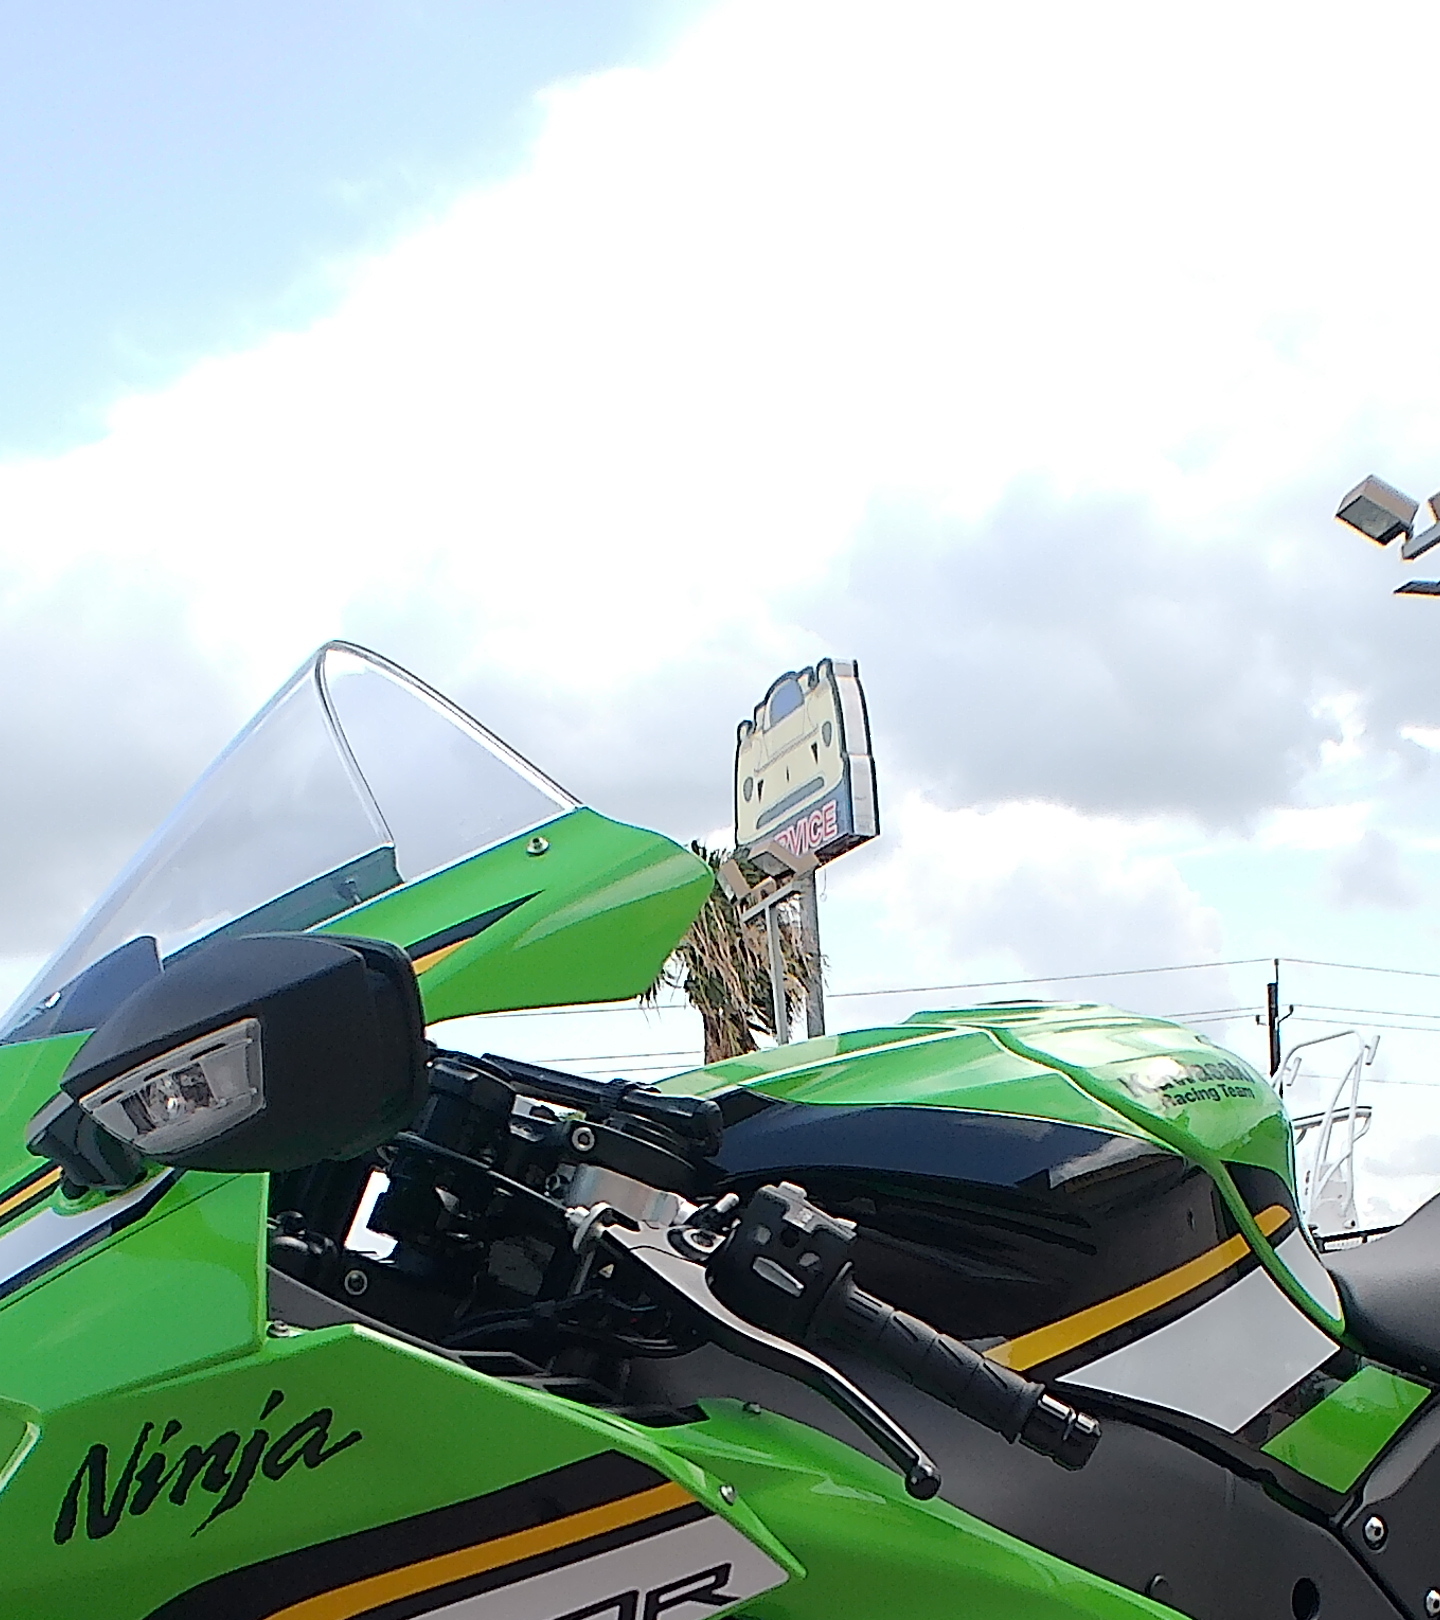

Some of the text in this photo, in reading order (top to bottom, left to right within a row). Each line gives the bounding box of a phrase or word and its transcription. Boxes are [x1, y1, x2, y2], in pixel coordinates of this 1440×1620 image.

[1161, 1083, 1256, 1109] Racing Team
[53, 1389, 363, 1545] Ninja
